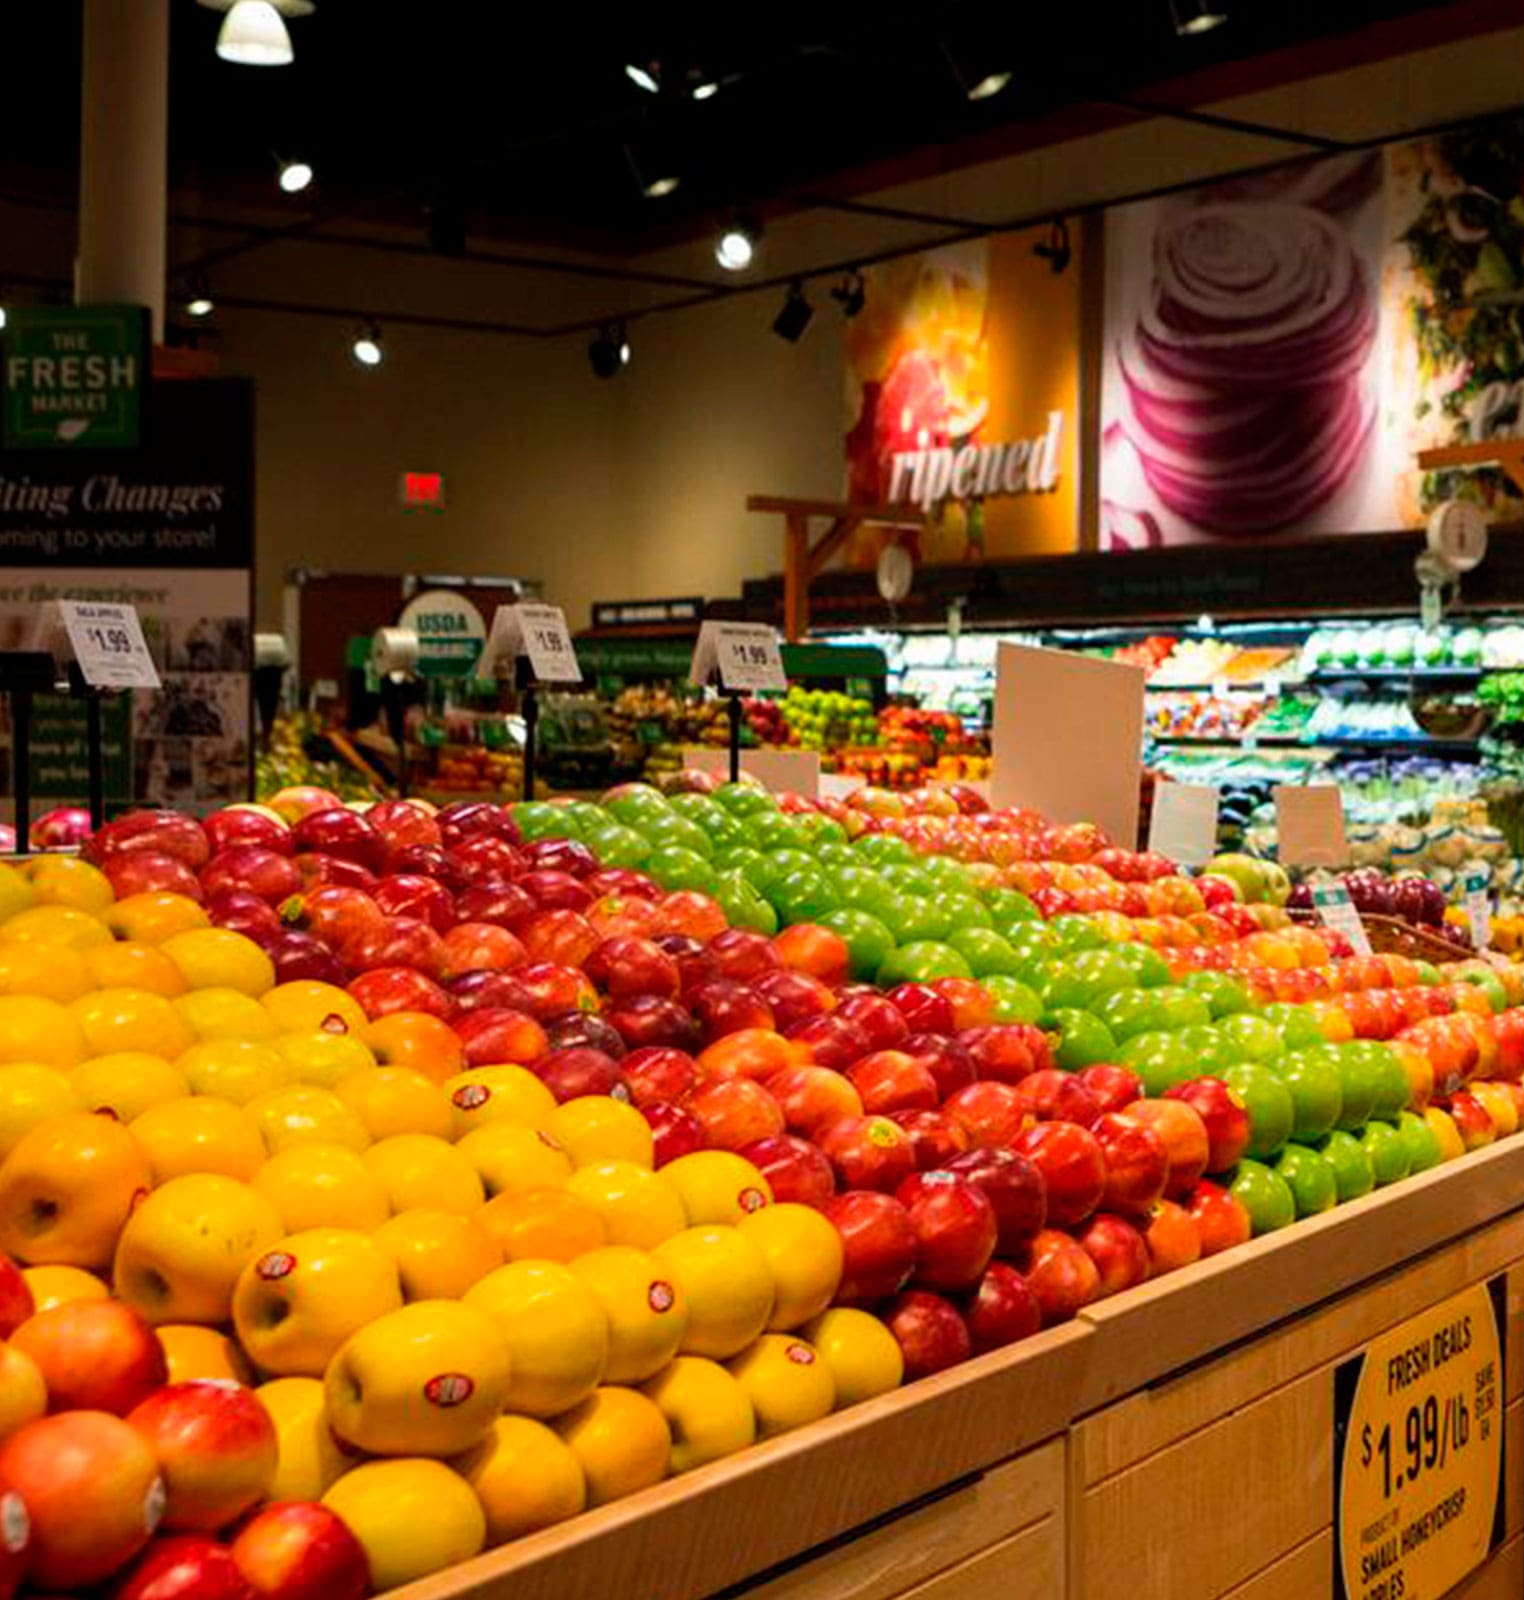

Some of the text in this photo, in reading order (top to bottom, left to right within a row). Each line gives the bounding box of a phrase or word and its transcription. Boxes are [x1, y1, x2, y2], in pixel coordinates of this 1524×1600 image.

[53, 332, 89, 350] THE
[8, 355, 136, 390] FRESH
[32, 394, 108, 412] MARKET
[888, 410, 1063, 514] ripened
[81, 473, 225, 521] Changes
[63, 527, 91, 547] to
[94, 531, 147, 555] your
[417, 612, 469, 632] USDA
[87, 626, 131, 654] $1.99
[1387, 1315, 1472, 1396] FRESH DEALS
[1361, 1487, 1467, 1585] SMALL HONEYCRISP
